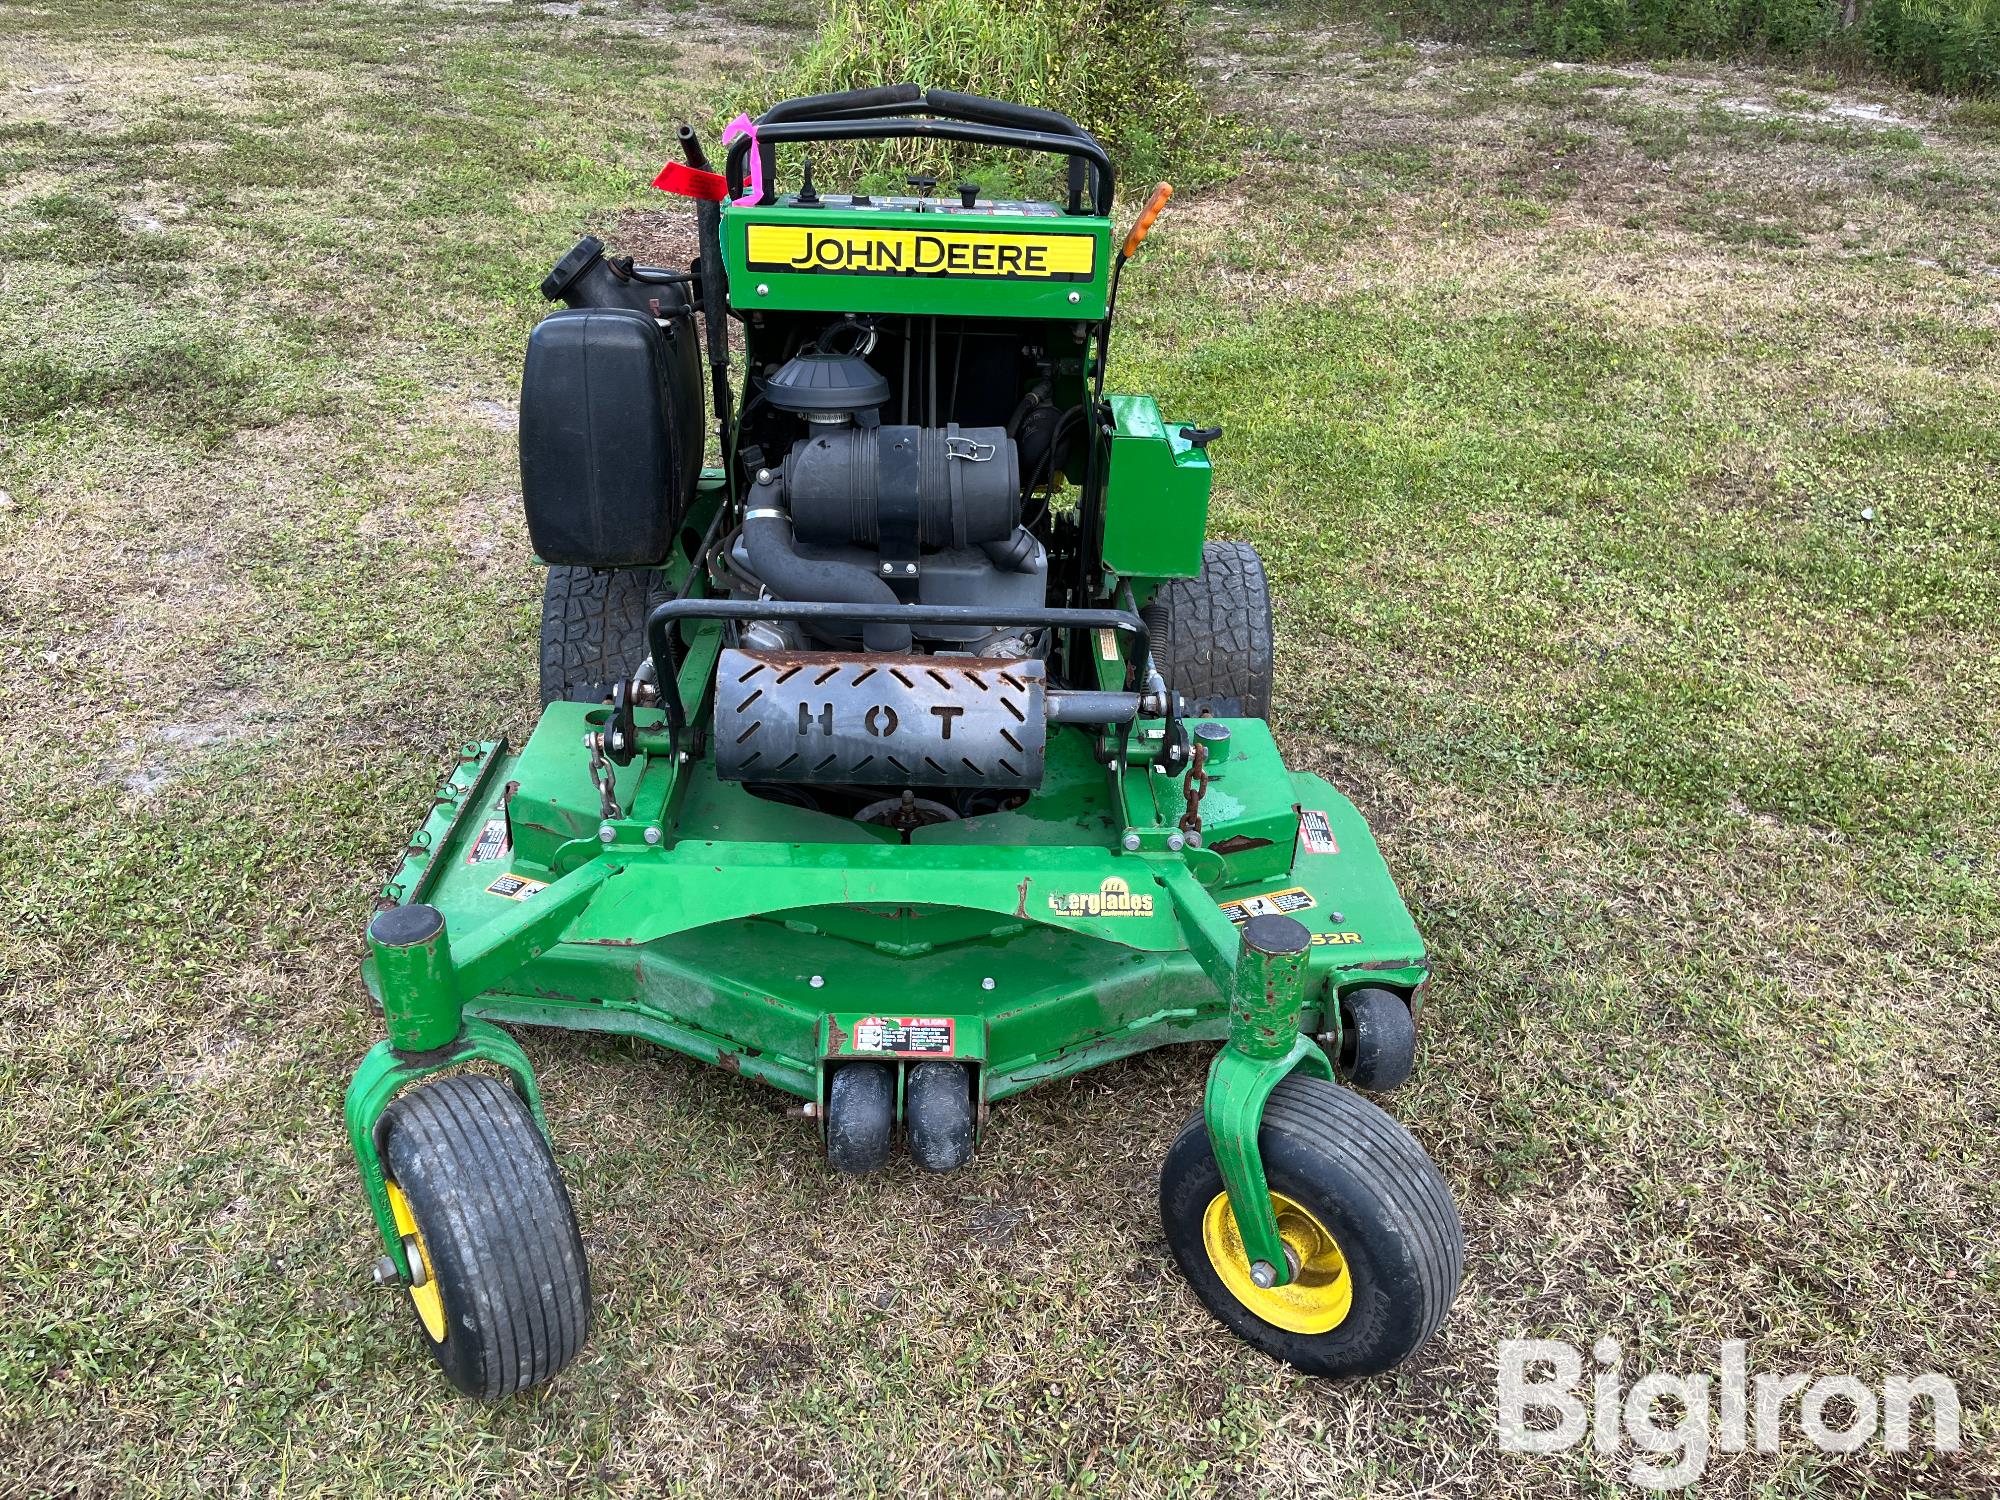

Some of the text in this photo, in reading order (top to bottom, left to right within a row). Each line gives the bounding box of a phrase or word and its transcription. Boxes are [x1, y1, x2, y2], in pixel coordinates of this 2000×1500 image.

[792, 232, 1048, 272] JOHN DEERE
[798, 702, 964, 740] HOT
